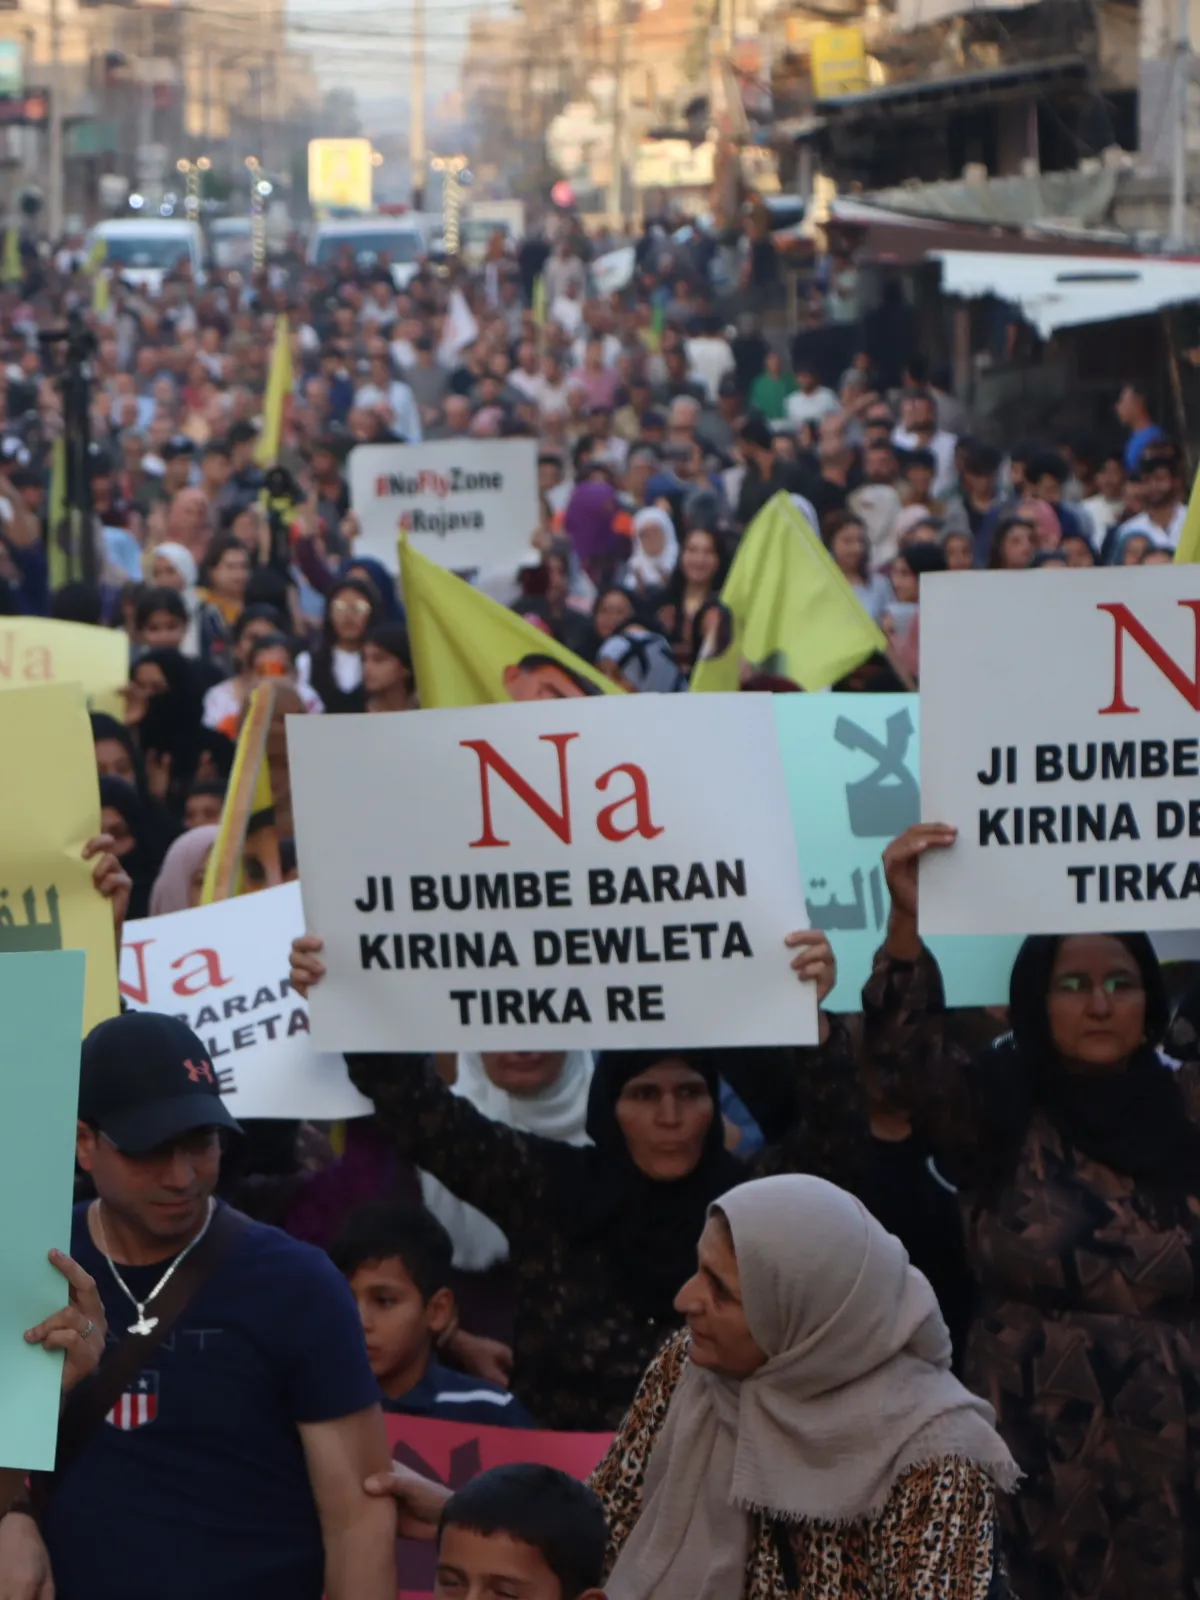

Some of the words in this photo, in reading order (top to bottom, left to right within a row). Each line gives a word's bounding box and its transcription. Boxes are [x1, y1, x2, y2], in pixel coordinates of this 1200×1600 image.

[375, 468, 503, 499] #NoFlyZone
[977, 746, 1017, 786] JI
[1035, 738, 1200, 783] BUMBE
[459, 732, 665, 848] Na
[979, 802, 1141, 847] KIRINA
[355, 875, 394, 913] JI
[410, 870, 574, 912] BUMBE
[588, 859, 747, 906] BARAN
[359, 931, 519, 970] KIRINA
[533, 921, 754, 967] DEWLETA
[449, 987, 593, 1026] TIRKA
[606, 985, 666, 1022] RE
